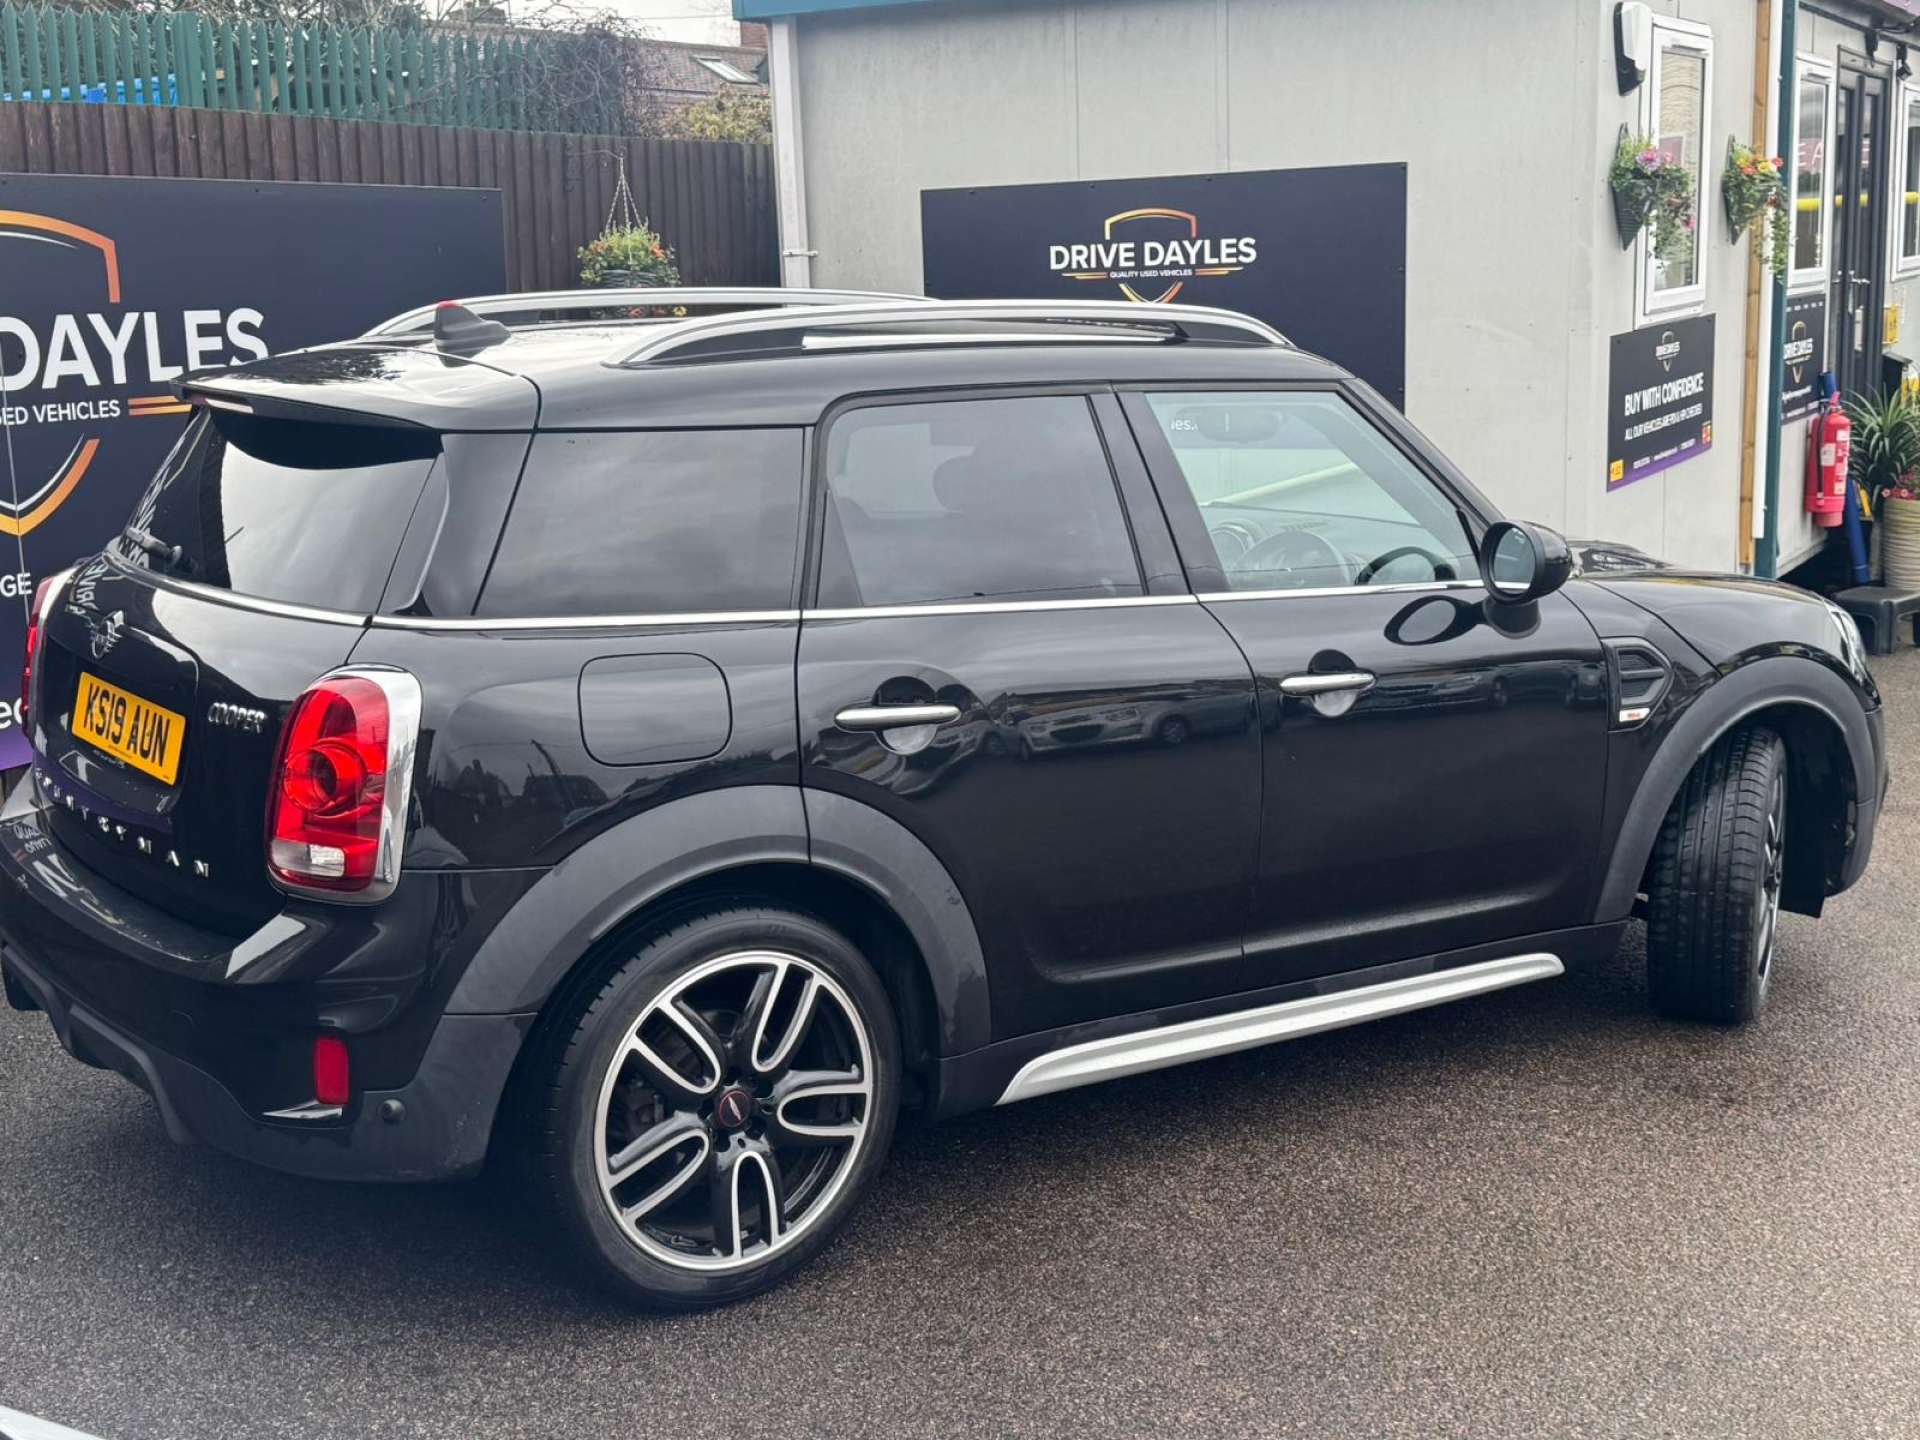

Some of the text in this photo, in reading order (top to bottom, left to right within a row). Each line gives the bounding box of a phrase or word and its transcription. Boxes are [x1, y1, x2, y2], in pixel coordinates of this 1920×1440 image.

[1050, 237, 1257, 270] DRIVE DAYLES
[1110, 270, 1138, 278] QUALITY
[1159, 269, 1193, 277] VEHICLES
[1624, 391, 1641, 416] BUY
[1642, 385, 1662, 410] WITH
[1662, 372, 1704, 404] CONFIDENCE
[32, 399, 121, 423] VEHICLES
[83, 683, 170, 767] KS19 AUN
[208, 702, 265, 734] COOPER
